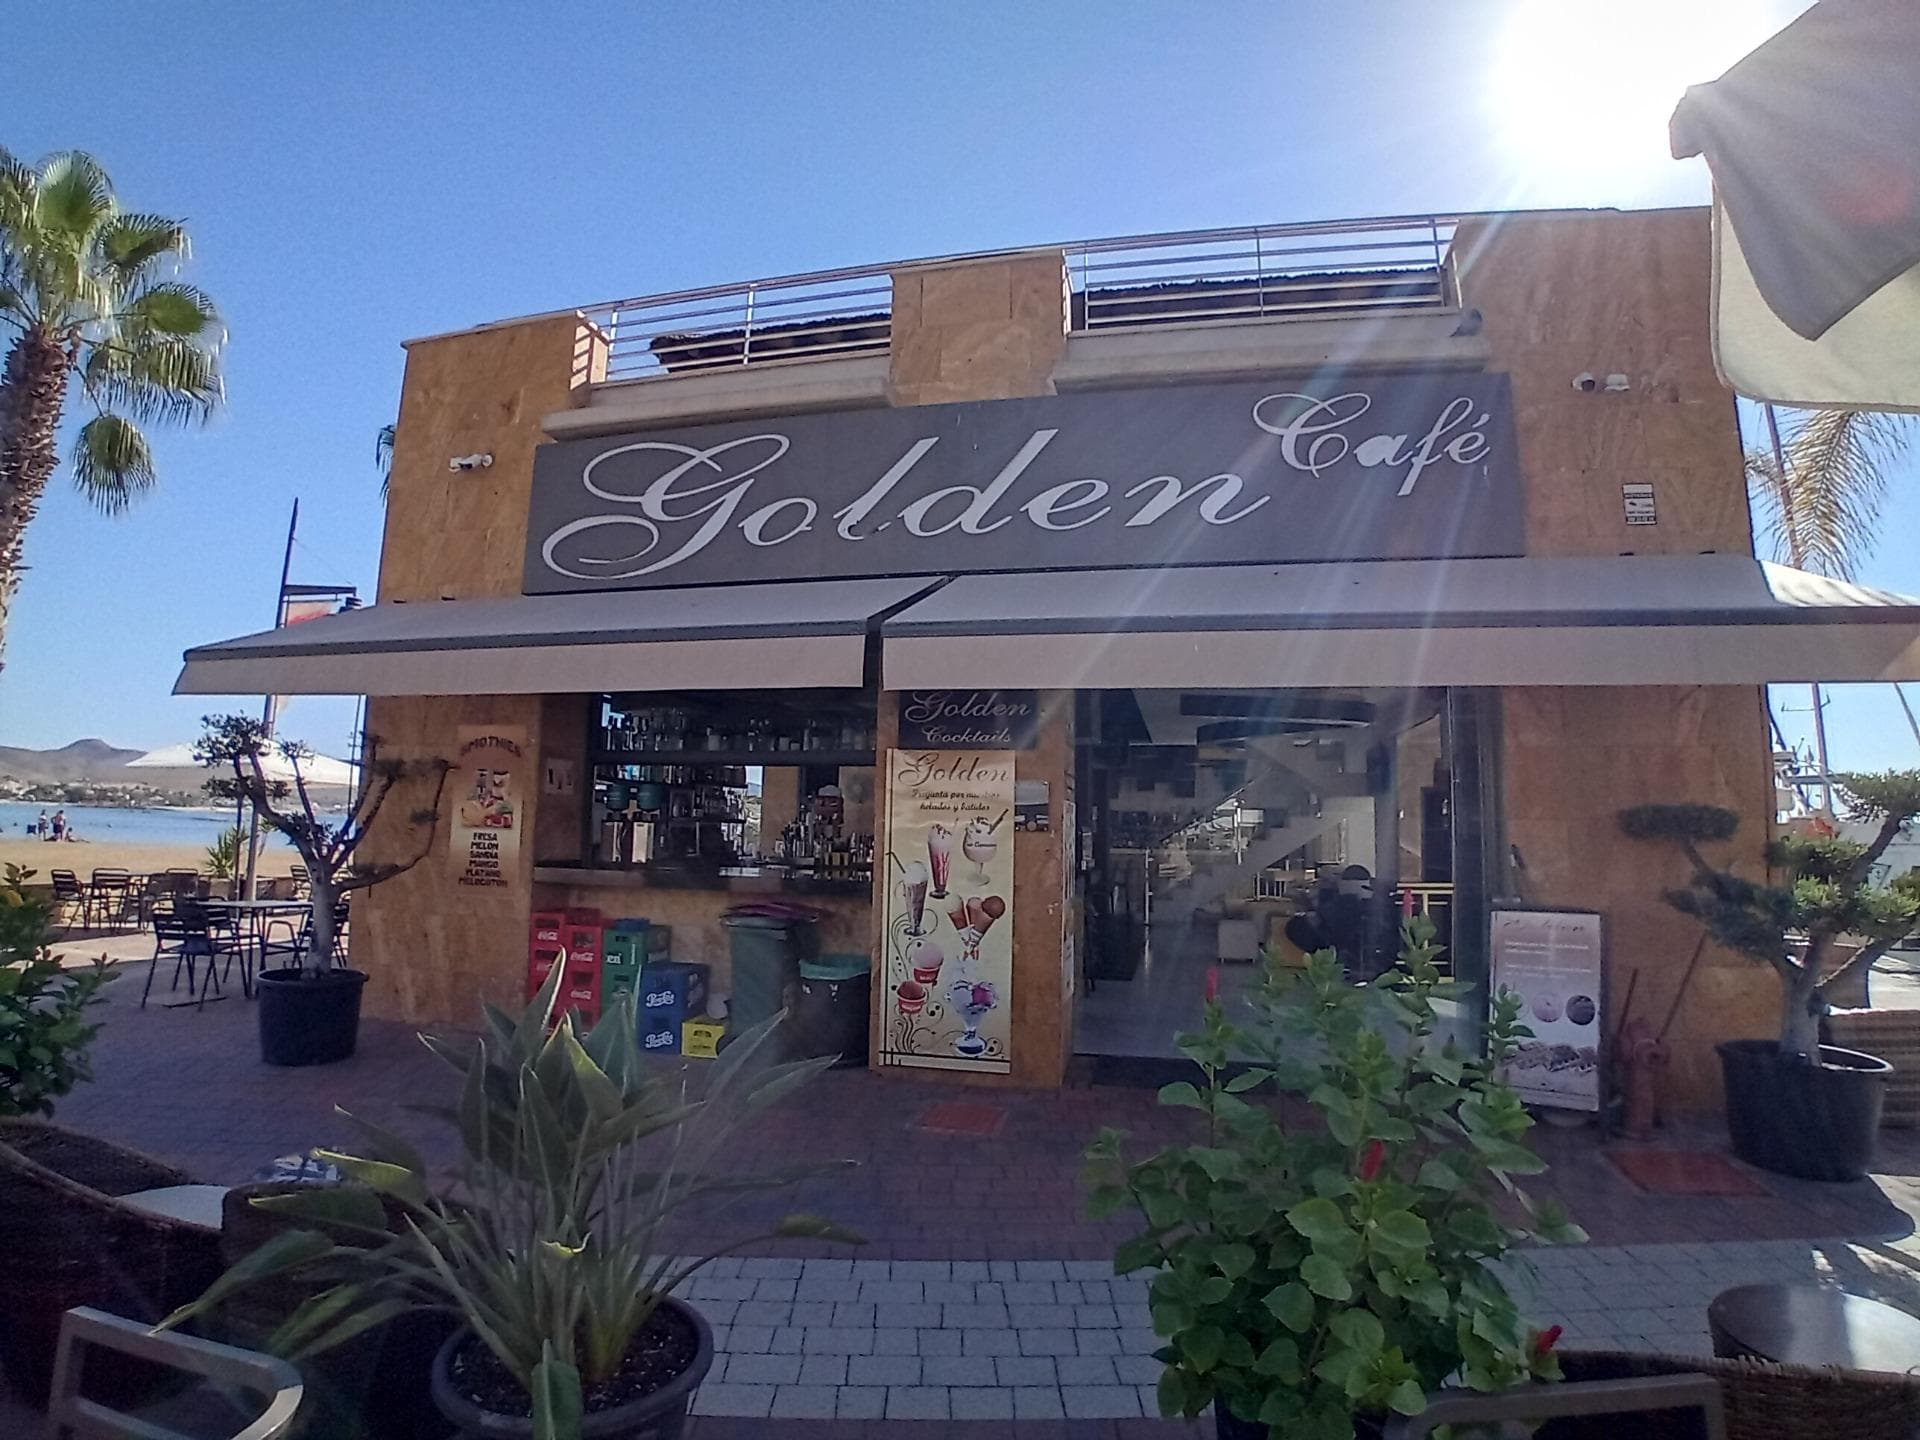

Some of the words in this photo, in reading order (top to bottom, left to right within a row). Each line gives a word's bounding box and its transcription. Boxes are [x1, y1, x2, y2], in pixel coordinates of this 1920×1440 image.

[542, 428, 1270, 580] Golden
[1253, 392, 1491, 497] Café
[904, 689, 1032, 723] Golden
[922, 725, 1012, 744] Cocktails
[897, 752, 1010, 787] Golden
